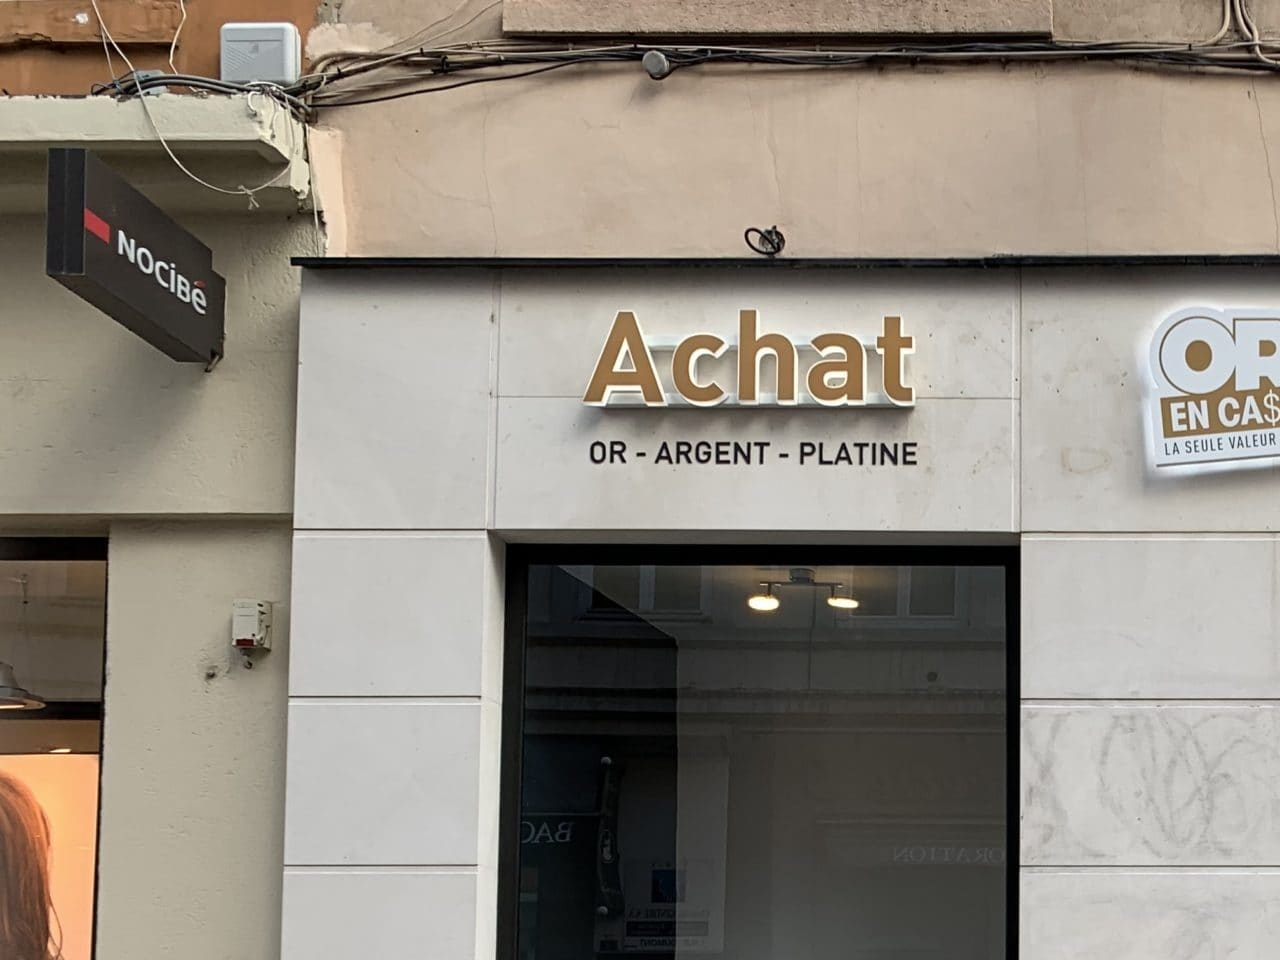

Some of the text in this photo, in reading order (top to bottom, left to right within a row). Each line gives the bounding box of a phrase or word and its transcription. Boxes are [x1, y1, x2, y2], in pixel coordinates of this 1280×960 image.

[583, 309, 915, 406] Achat
[1170, 400, 1210, 432] EN
[589, 441, 627, 463] OR
[654, 441, 770, 464] ARGENT
[800, 442, 917, 465] PLATINE
[1165, 442, 1180, 455] LA
[1185, 437, 1224, 454] SEULE
[1229, 432, 1276, 450] VALEUR
